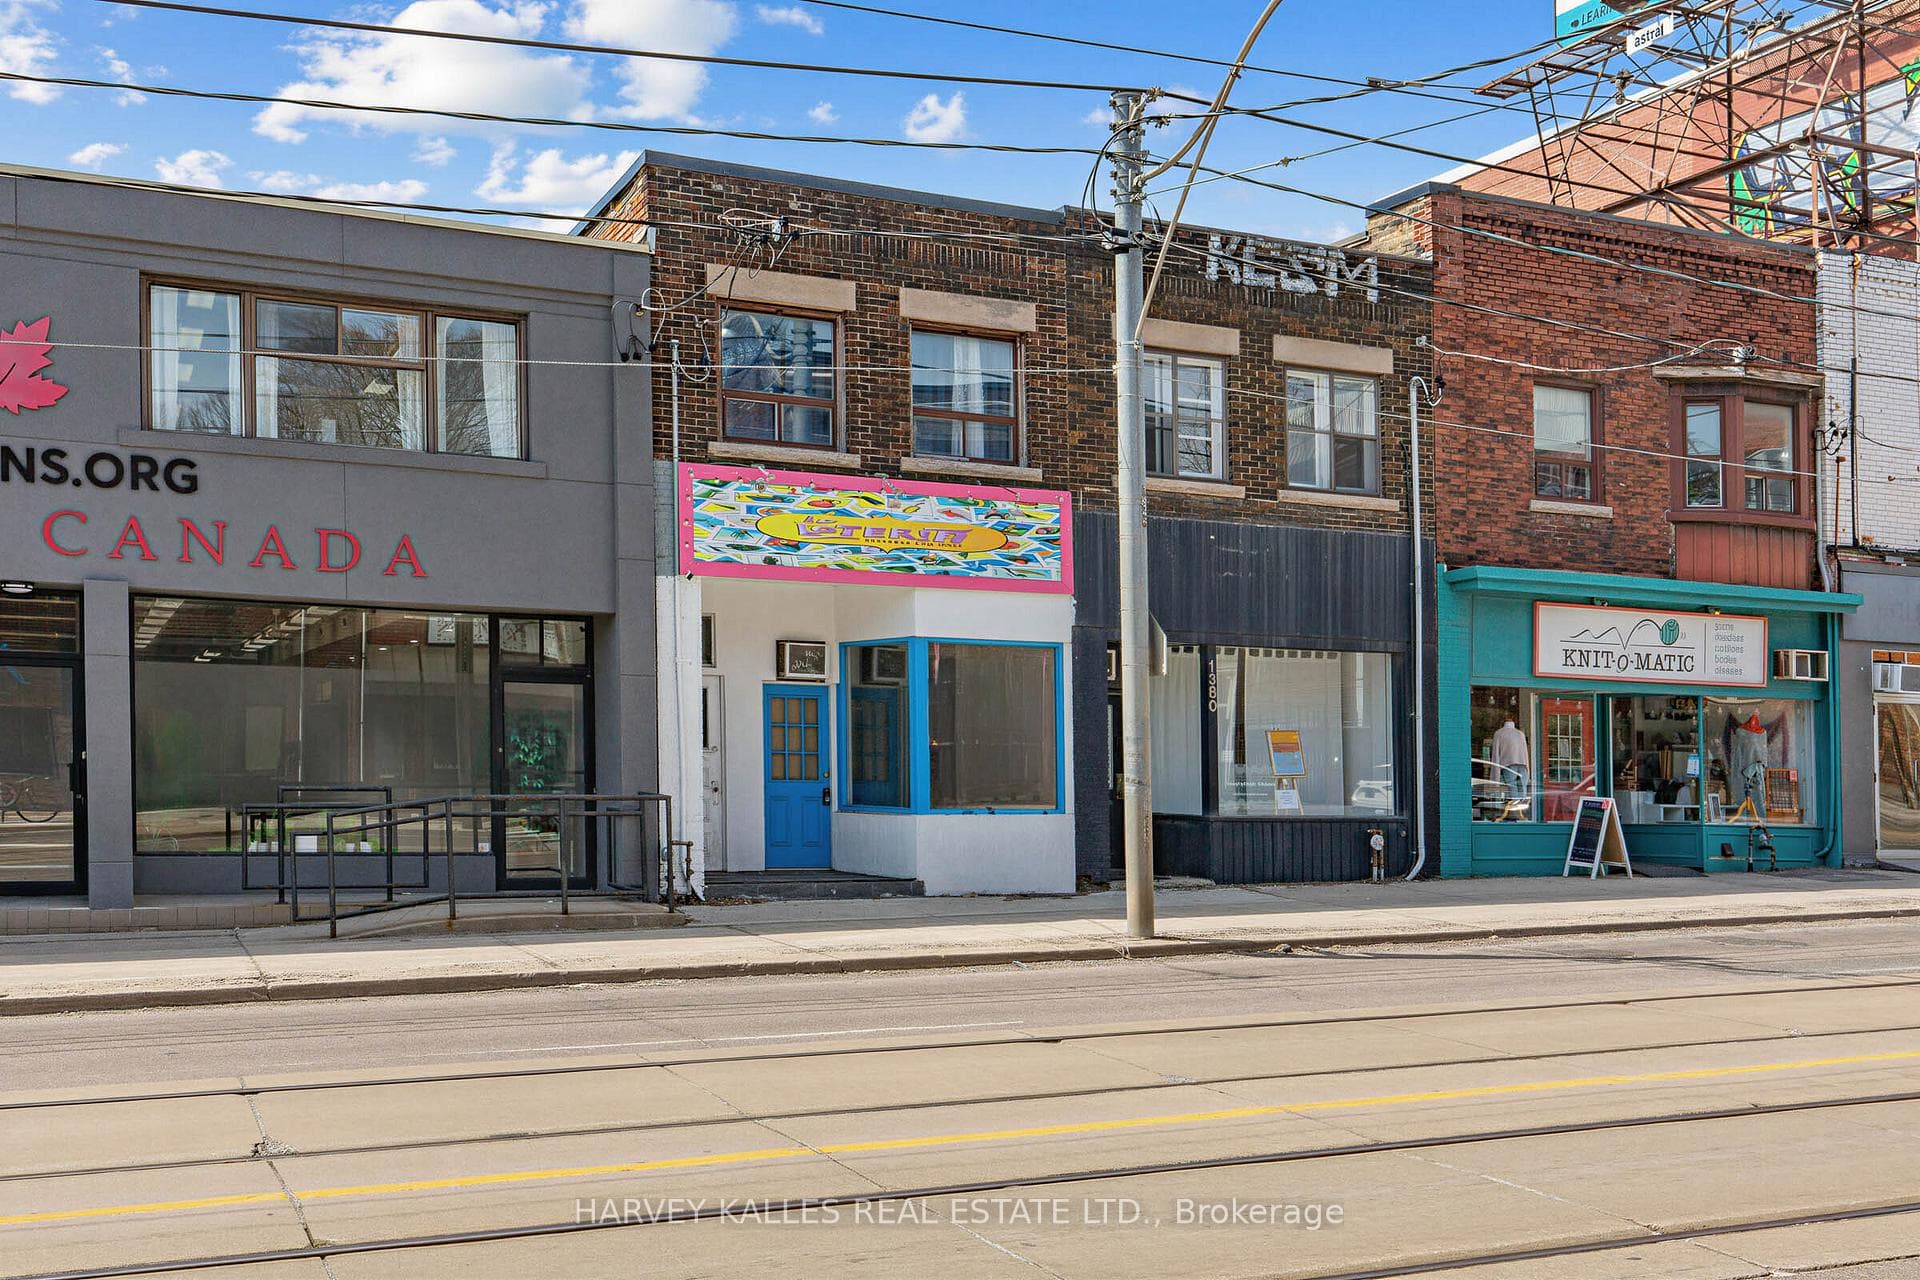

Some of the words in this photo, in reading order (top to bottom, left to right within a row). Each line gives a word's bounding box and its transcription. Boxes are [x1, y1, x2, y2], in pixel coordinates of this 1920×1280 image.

[1634, 24, 1664, 48] astral
[0, 445, 199, 494] NS.ORG
[42, 510, 428, 577] CANADA
[1208, 659, 1217, 712] 1380
